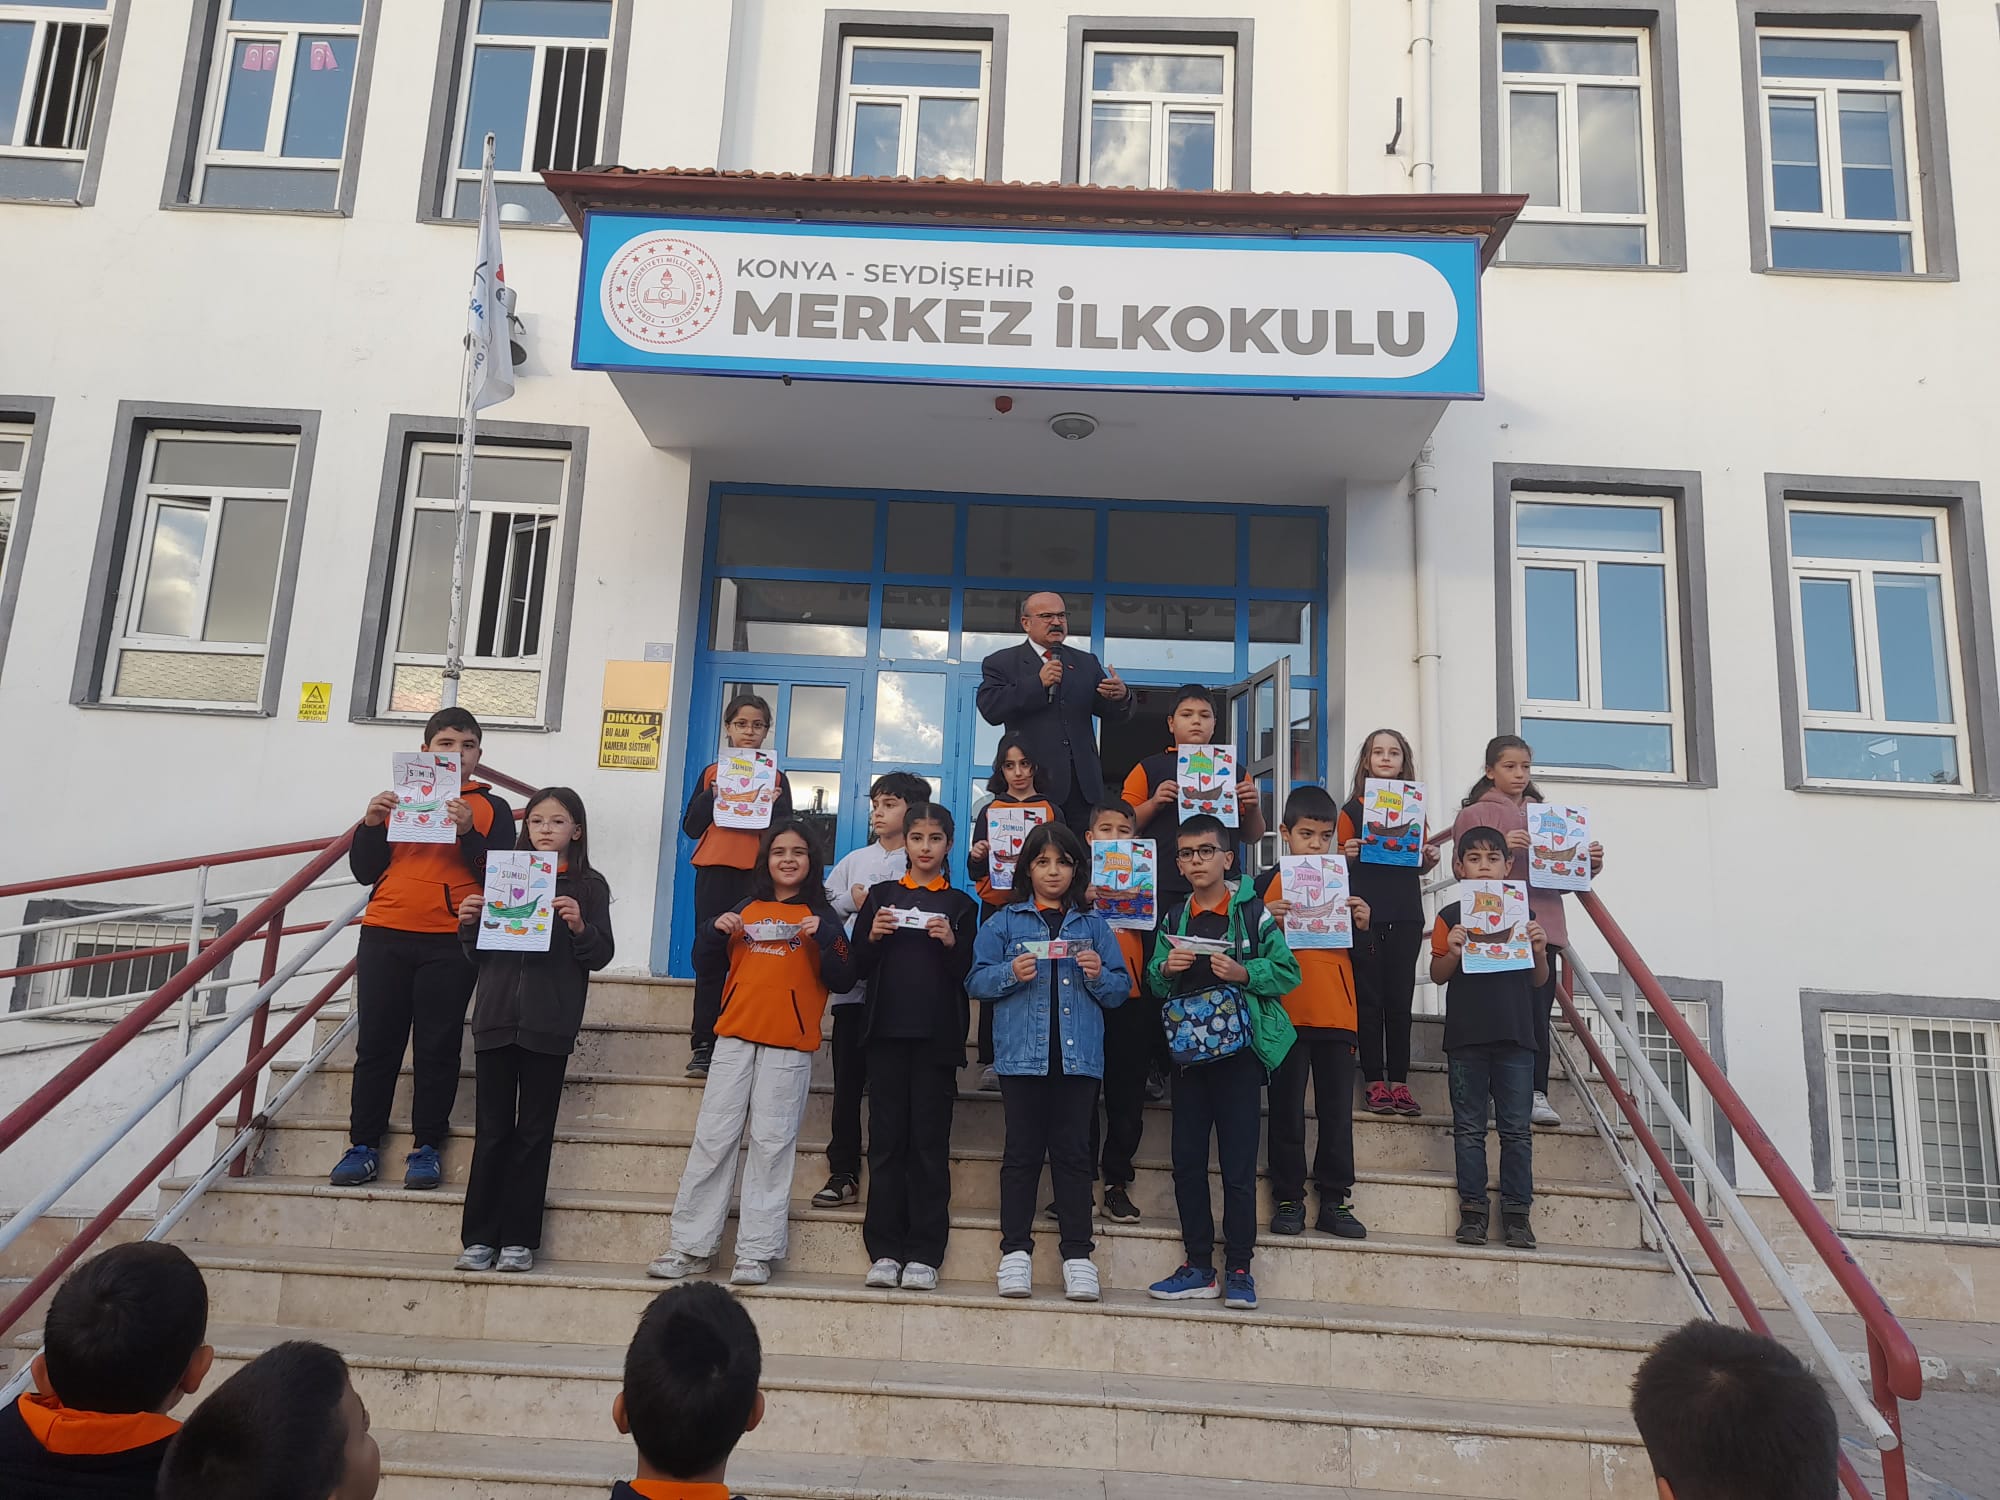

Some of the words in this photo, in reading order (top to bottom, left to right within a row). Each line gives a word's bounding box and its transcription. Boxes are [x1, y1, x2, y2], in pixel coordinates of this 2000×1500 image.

[737, 258, 837, 281] KONYA
[864, 262, 1034, 292] SEYDİŞEHİR
[733, 290, 1032, 346] MERKEZ
[1056, 285, 1425, 358] İLKOKULU
[605, 728, 614, 736] BU
[614, 728, 630, 738] ALAN
[604, 740, 628, 751] KAMERA
[501, 870, 528, 880] SUMUD
